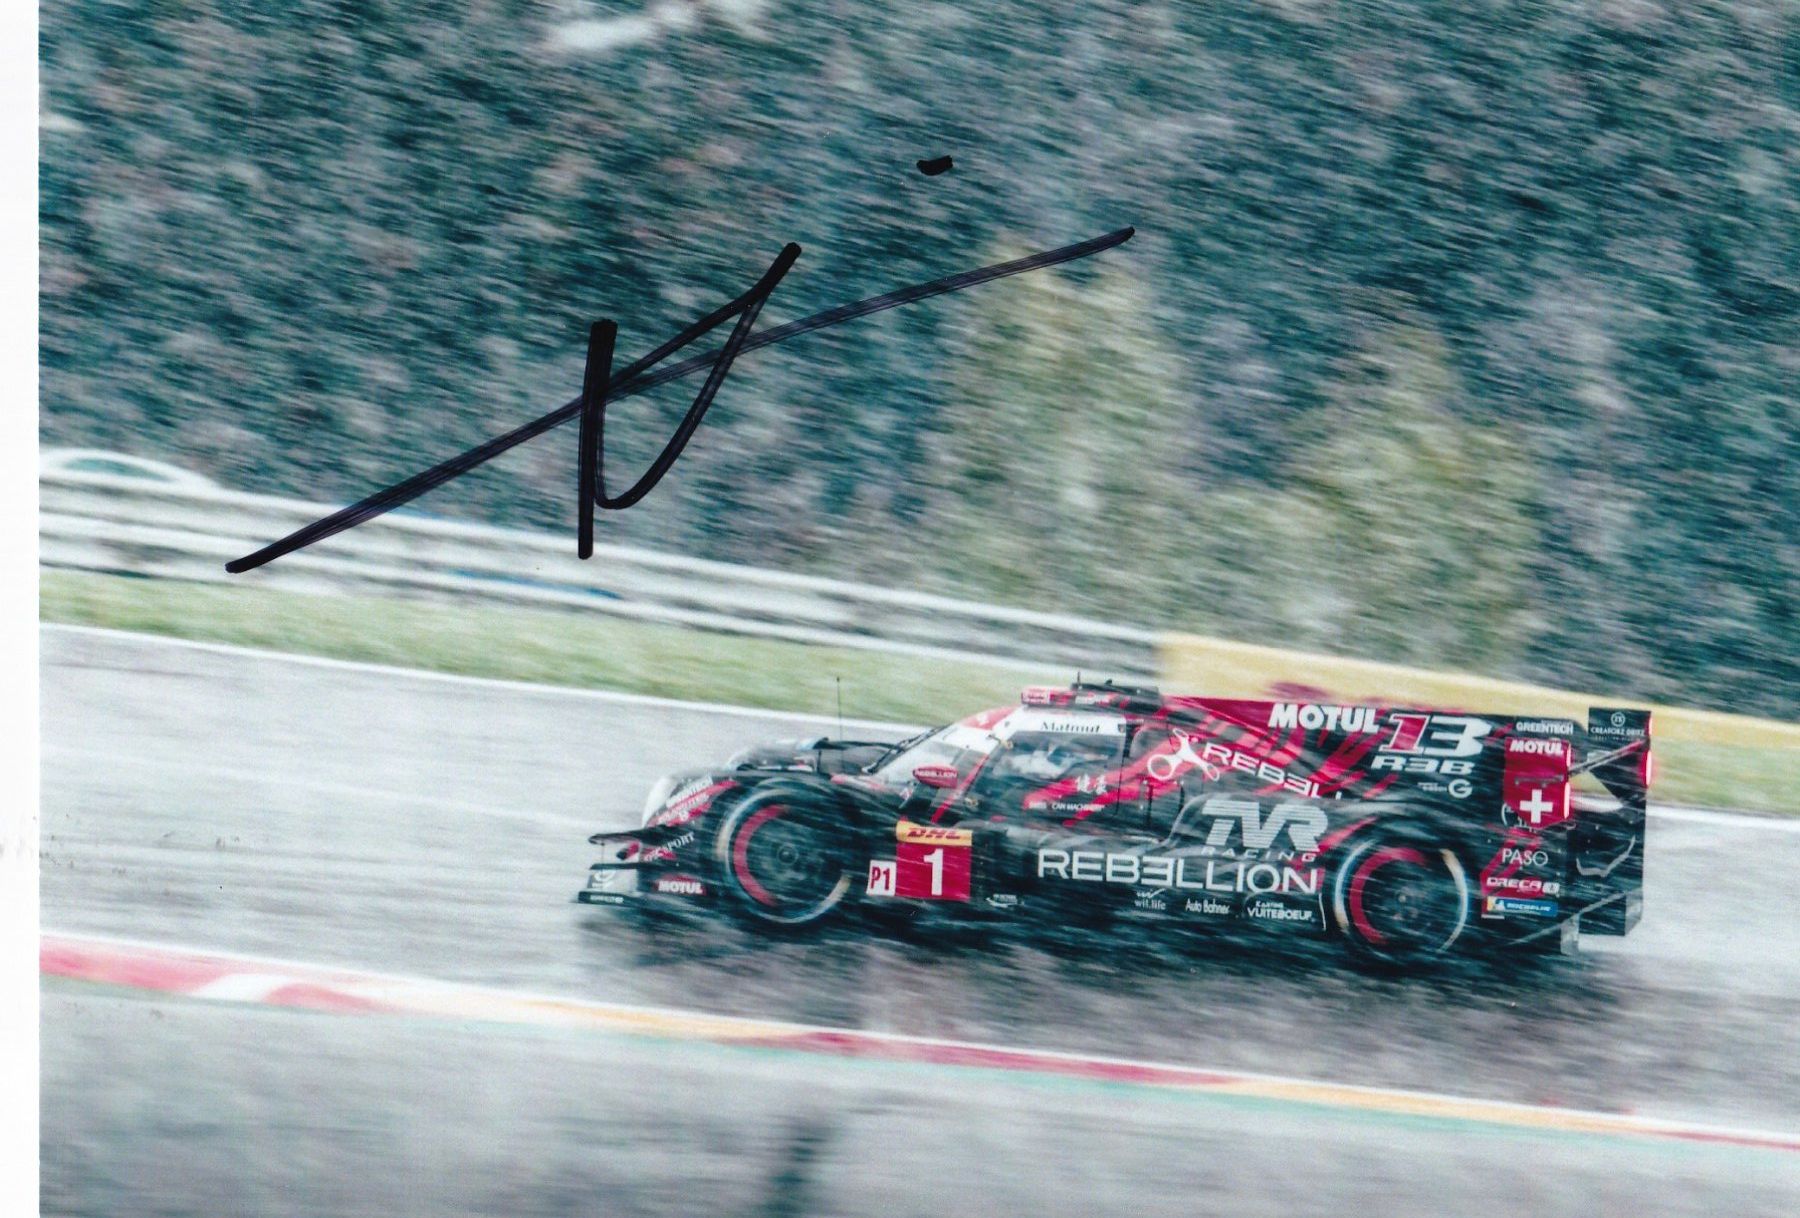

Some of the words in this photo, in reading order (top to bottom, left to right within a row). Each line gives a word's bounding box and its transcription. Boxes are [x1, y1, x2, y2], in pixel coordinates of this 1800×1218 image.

[1268, 703, 1380, 734] MOTUL
[1515, 721, 1574, 735] GREENTECH
[1378, 713, 1492, 758] 13
[1509, 739, 1565, 756] MOTUL
[907, 827, 962, 840] DHL
[1201, 799, 1329, 853] TVR
[1200, 847, 1318, 863] RACING
[1501, 847, 1549, 867] PASO
[870, 865, 891, 891] P1
[923, 848, 944, 896] 1
[1037, 848, 1318, 894] REBELLION
[657, 880, 703, 894] MOTUL
[1185, 897, 1201, 913] Auto
